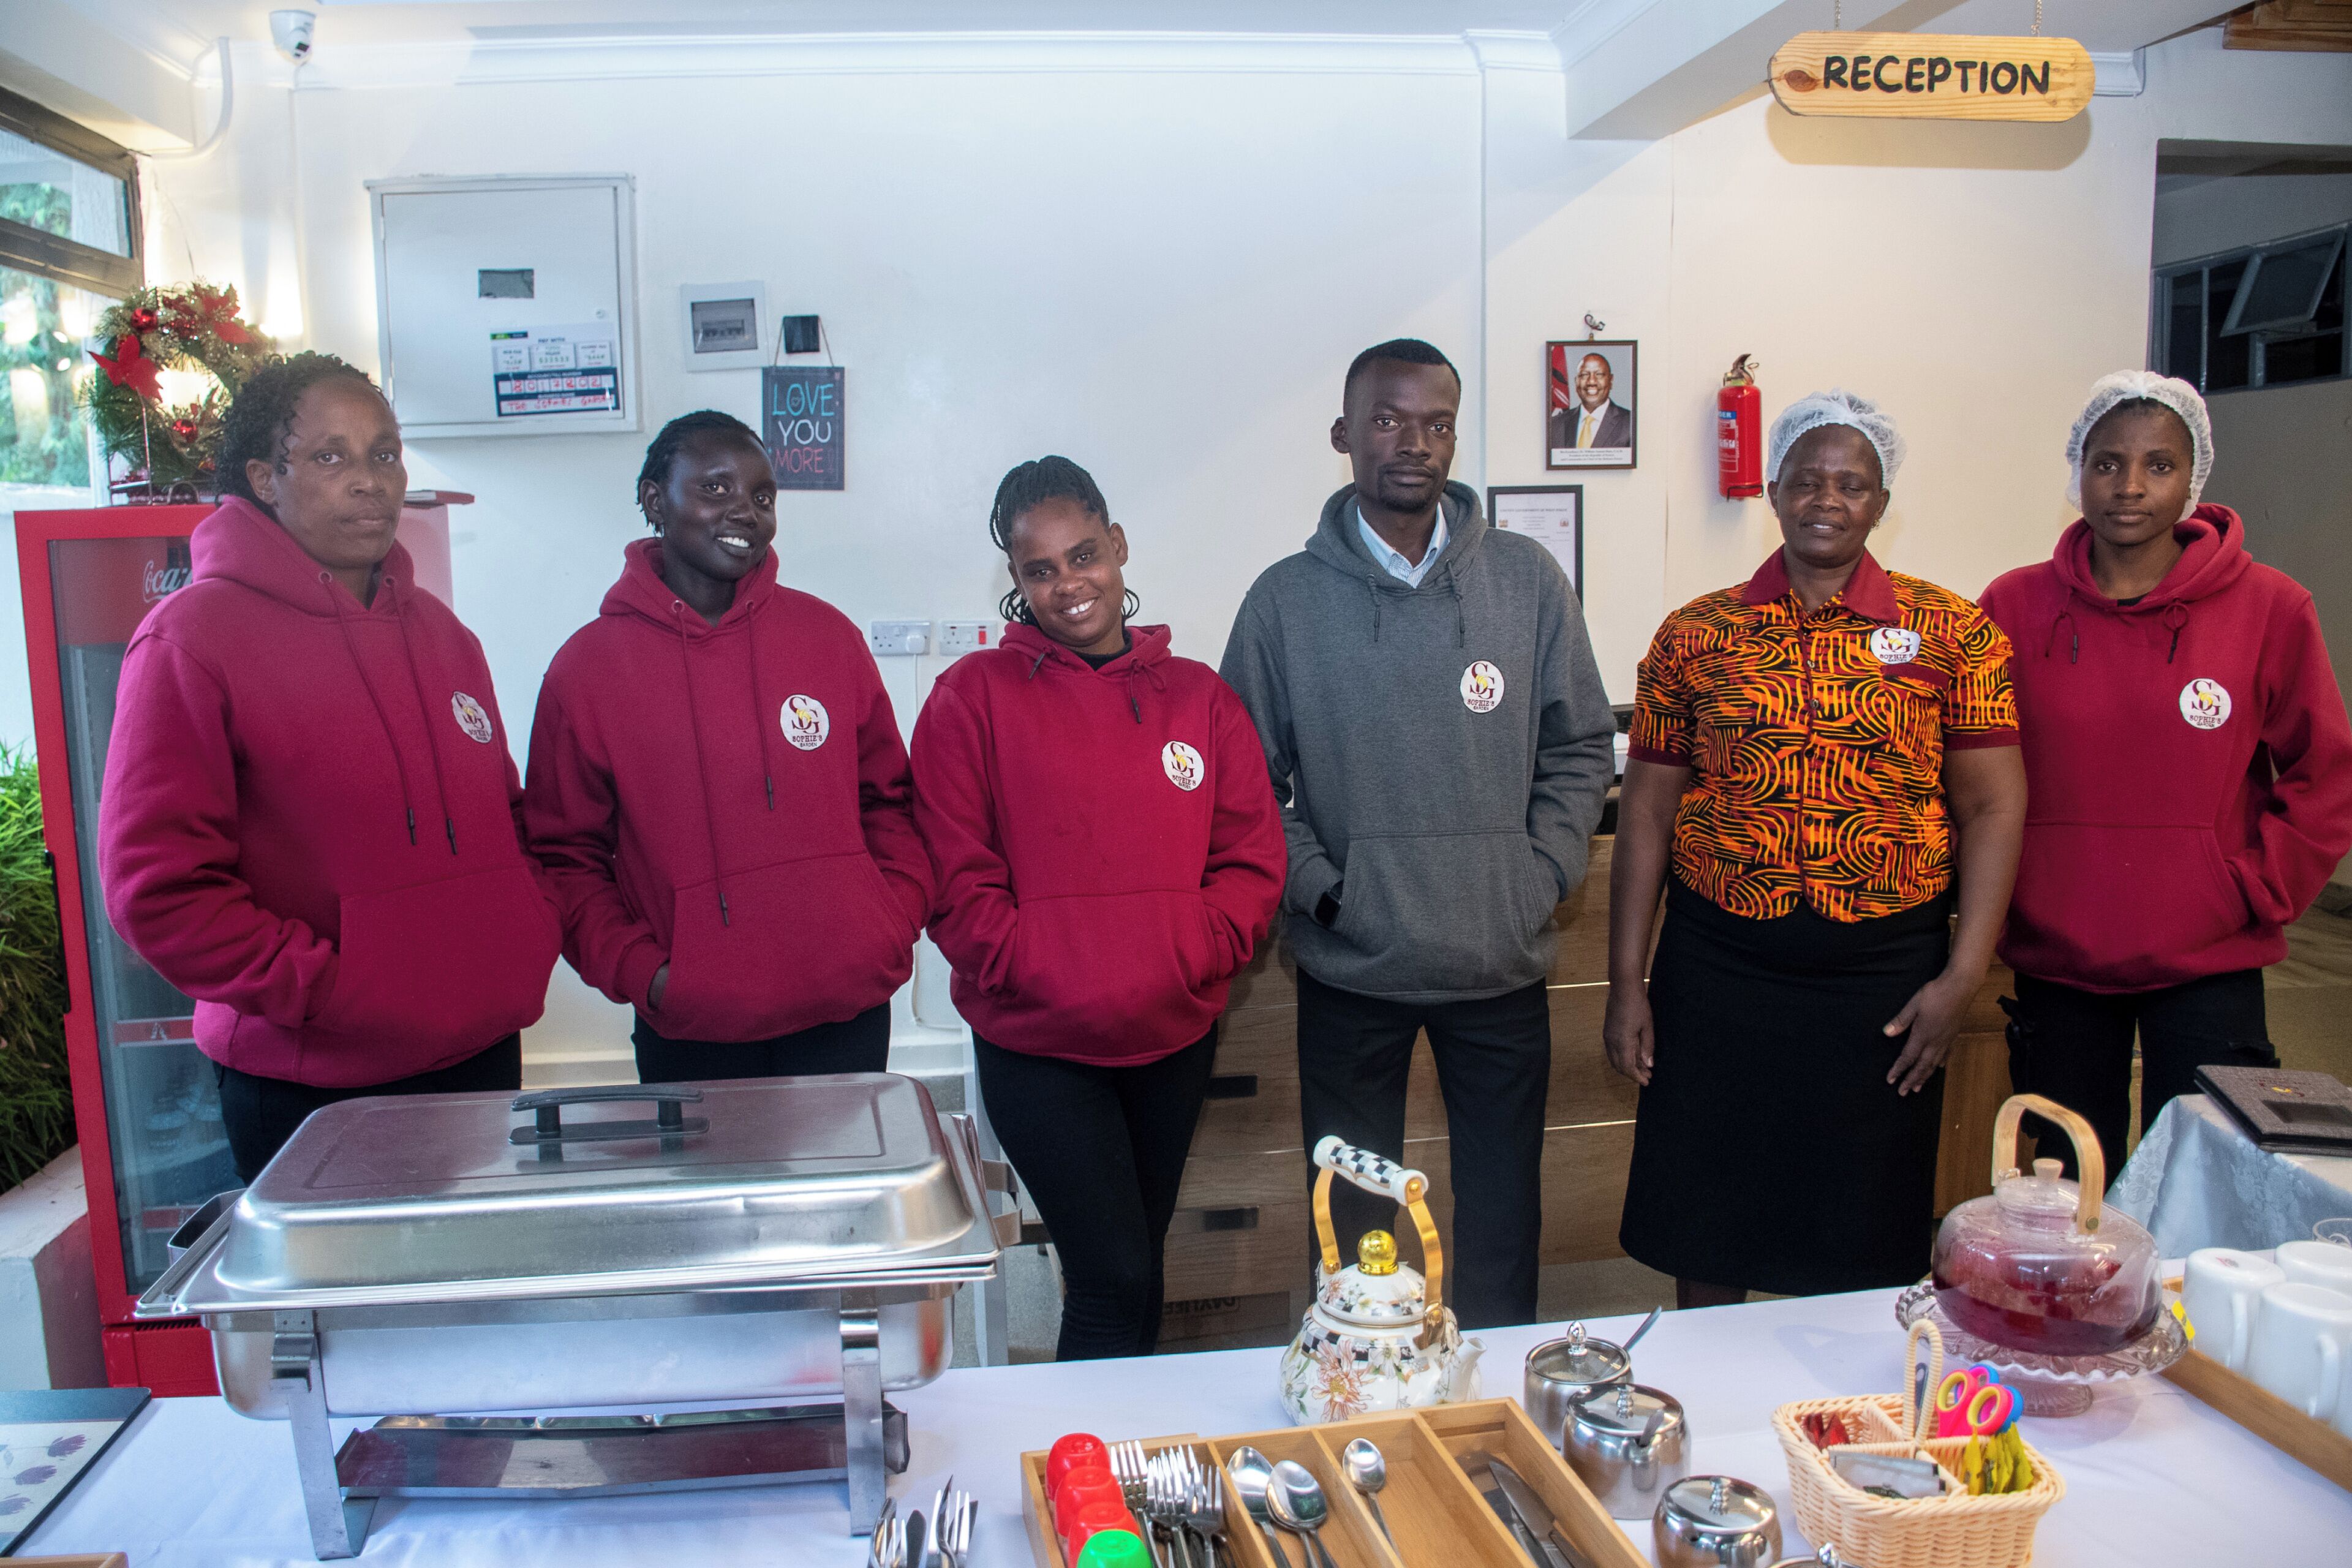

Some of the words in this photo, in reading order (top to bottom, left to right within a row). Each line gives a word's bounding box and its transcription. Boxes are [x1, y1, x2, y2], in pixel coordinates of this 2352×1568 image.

[1823, 55, 2049, 95] RECEPTION
[772, 381, 835, 417] LOVE
[778, 419, 831, 446] YOU
[2190, 715, 2221, 724] SOPHIE'S
